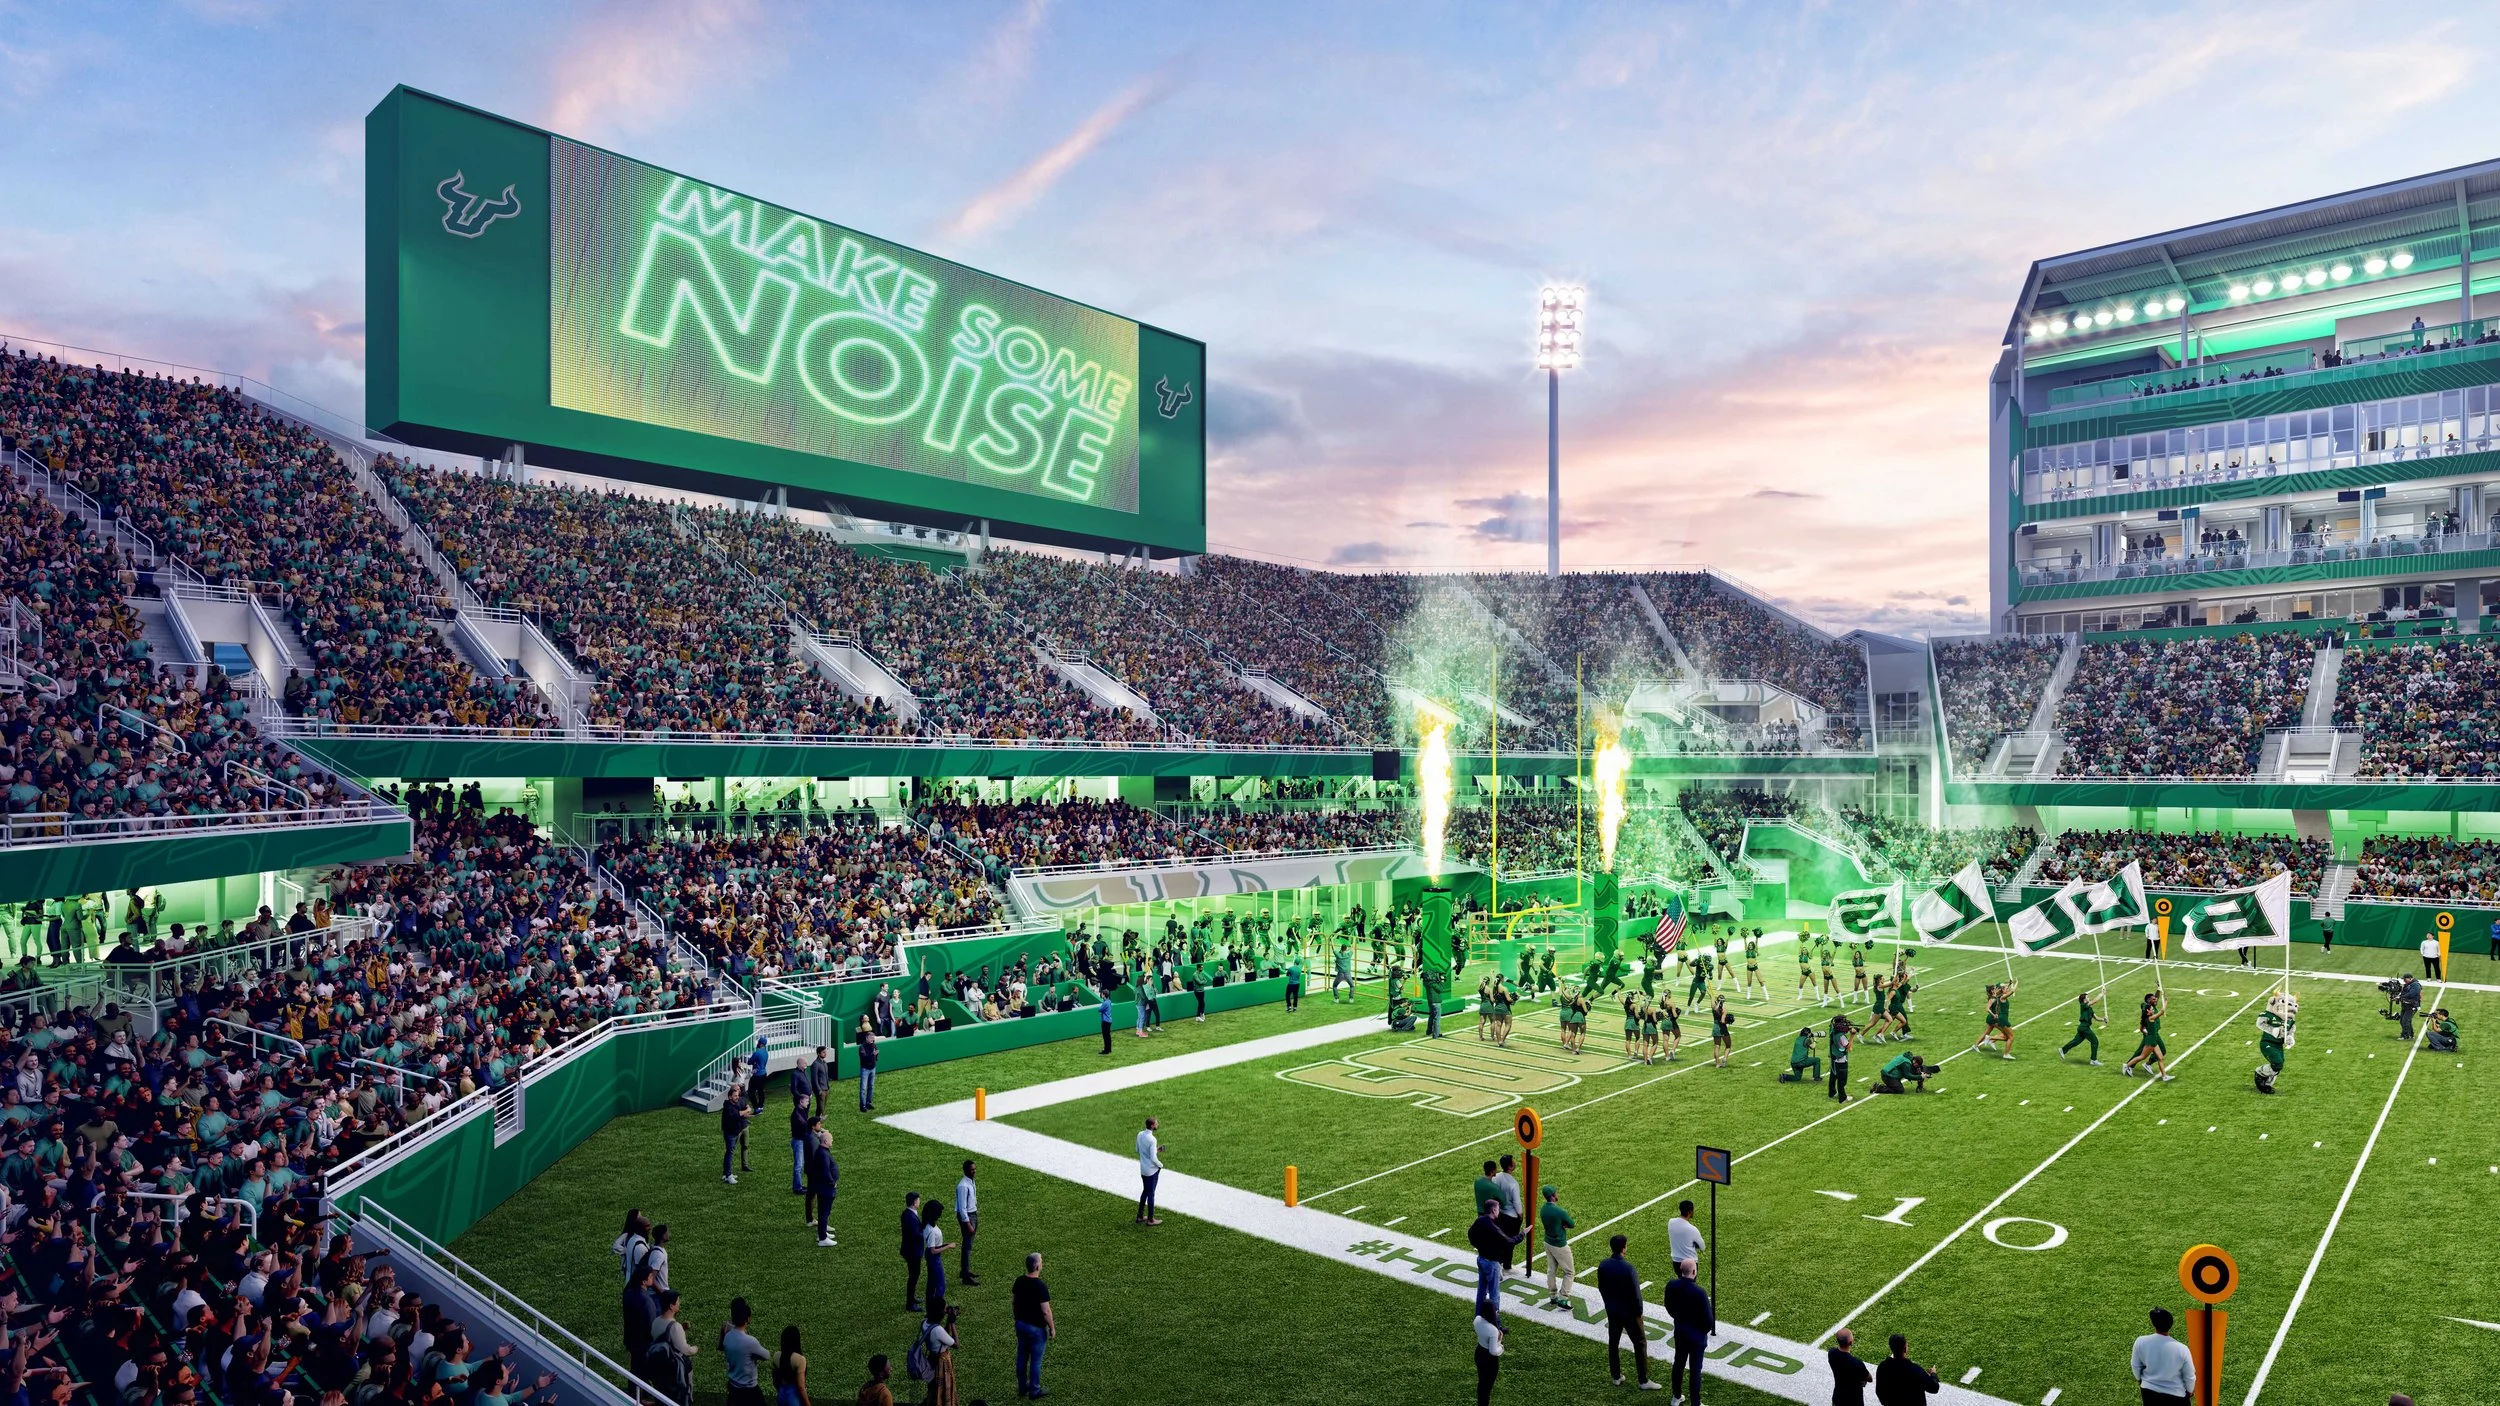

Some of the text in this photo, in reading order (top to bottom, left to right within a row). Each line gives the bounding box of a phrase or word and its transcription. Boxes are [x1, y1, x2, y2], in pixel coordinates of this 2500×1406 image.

[619, 221, 1116, 501] NOISE
[657, 176, 1133, 419] MAKE SOME
